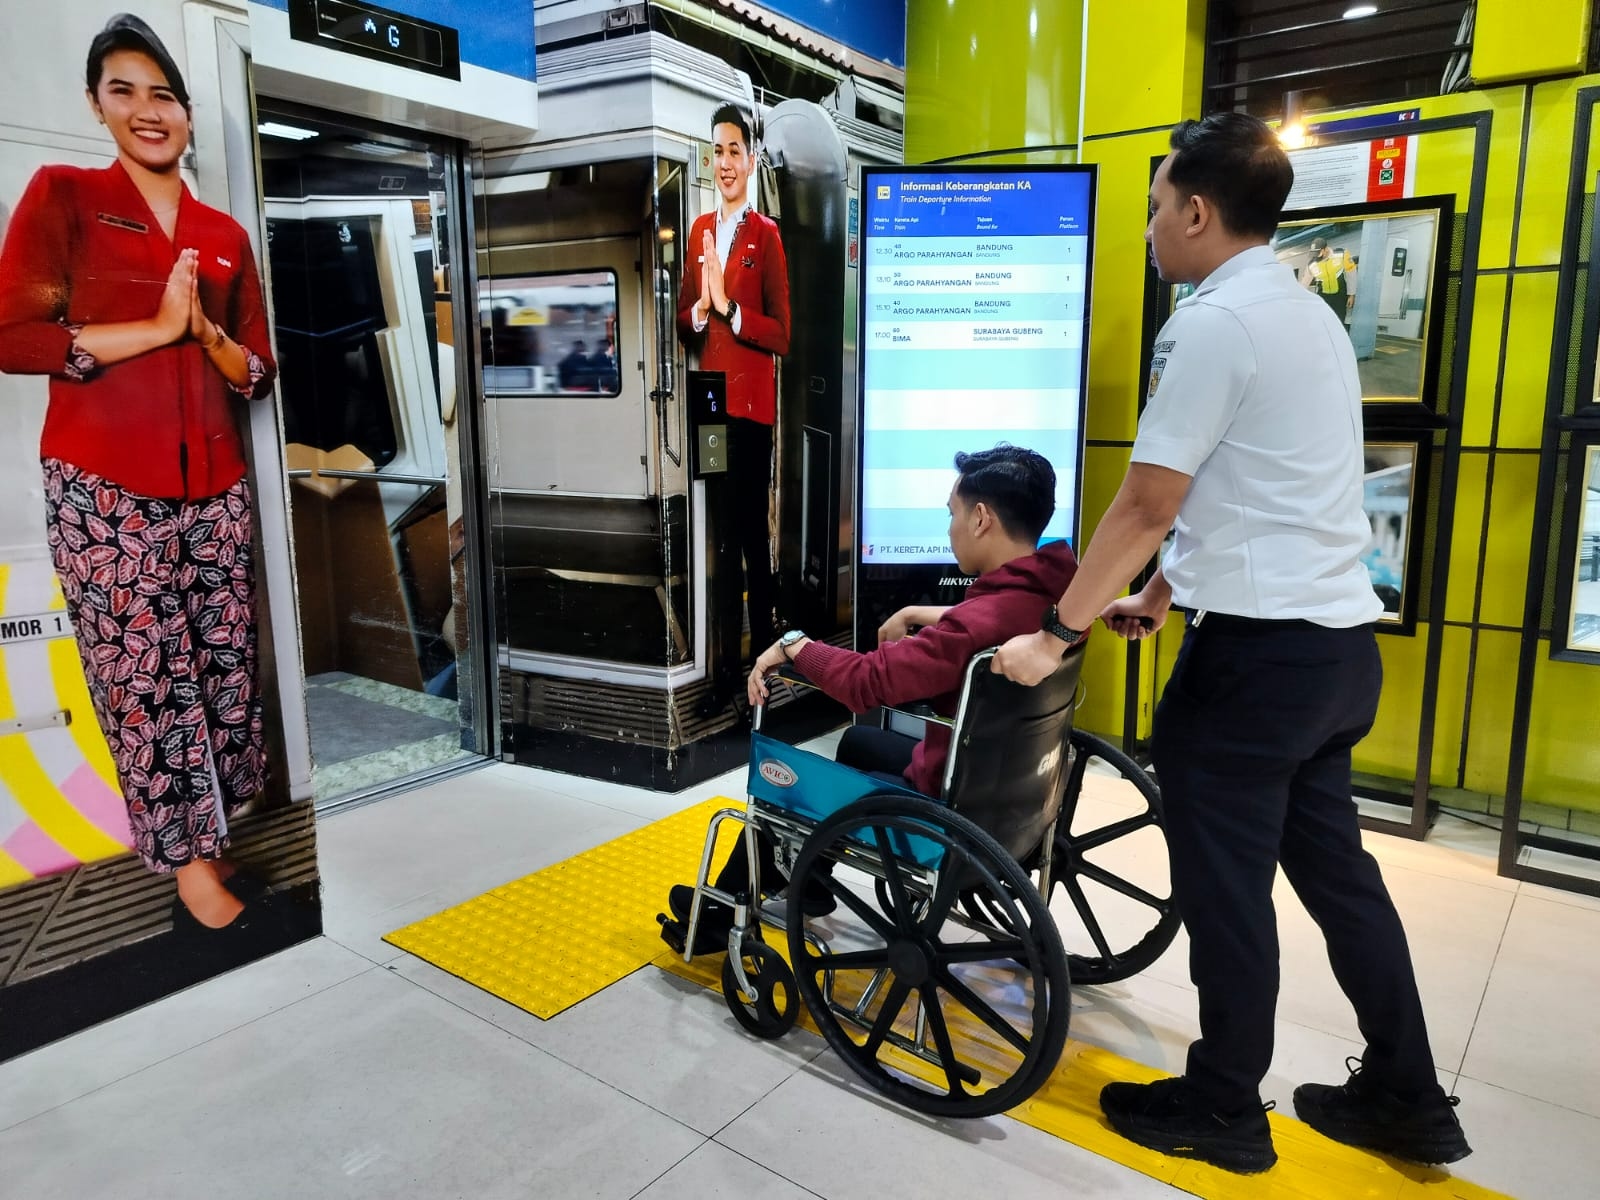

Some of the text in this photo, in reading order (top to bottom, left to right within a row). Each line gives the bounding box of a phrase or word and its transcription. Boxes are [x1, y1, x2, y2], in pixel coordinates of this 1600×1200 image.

[387, 25, 400, 48] G
[900, 180, 1031, 192] Informasi Keberangkatan KA
[900, 194, 991, 204] Train Departure Information
[894, 251, 973, 259] ARGO PARAHYANGAN
[893, 279, 972, 287] ARGO PARAHYANGAN
[893, 307, 915, 315] ARGO
[1012, 327, 1043, 335] GUBENG
[711, 401, 717, 412] G
[880, 546, 892, 554] PT.
[894, 546, 925, 554] KERETA
[927, 546, 941, 554] API
[0, 616, 62, 639] MOR 1
[763, 765, 791, 783] AVICO
